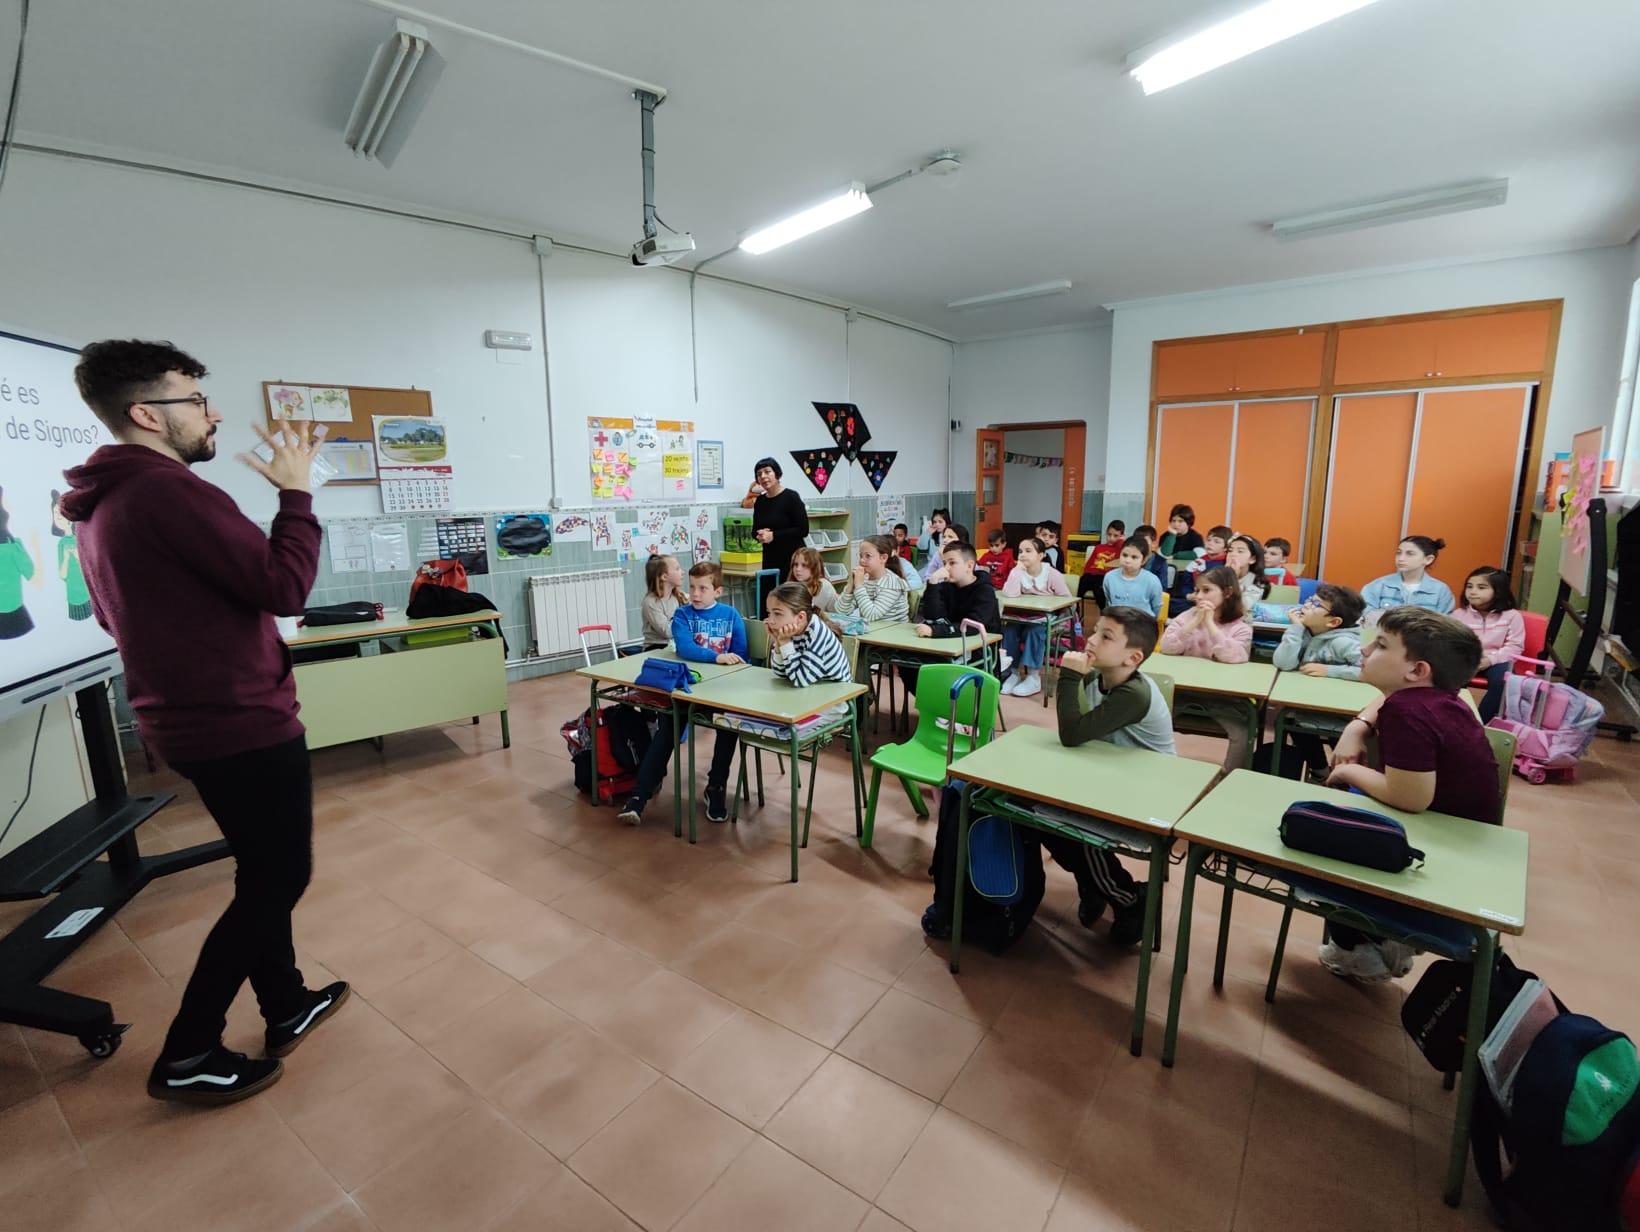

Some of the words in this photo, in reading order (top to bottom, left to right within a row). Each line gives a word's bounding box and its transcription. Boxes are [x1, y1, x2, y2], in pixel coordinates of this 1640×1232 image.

[18, 386, 40, 405] es
[6, 416, 30, 440] de
[34, 419, 99, 448] Signos?
